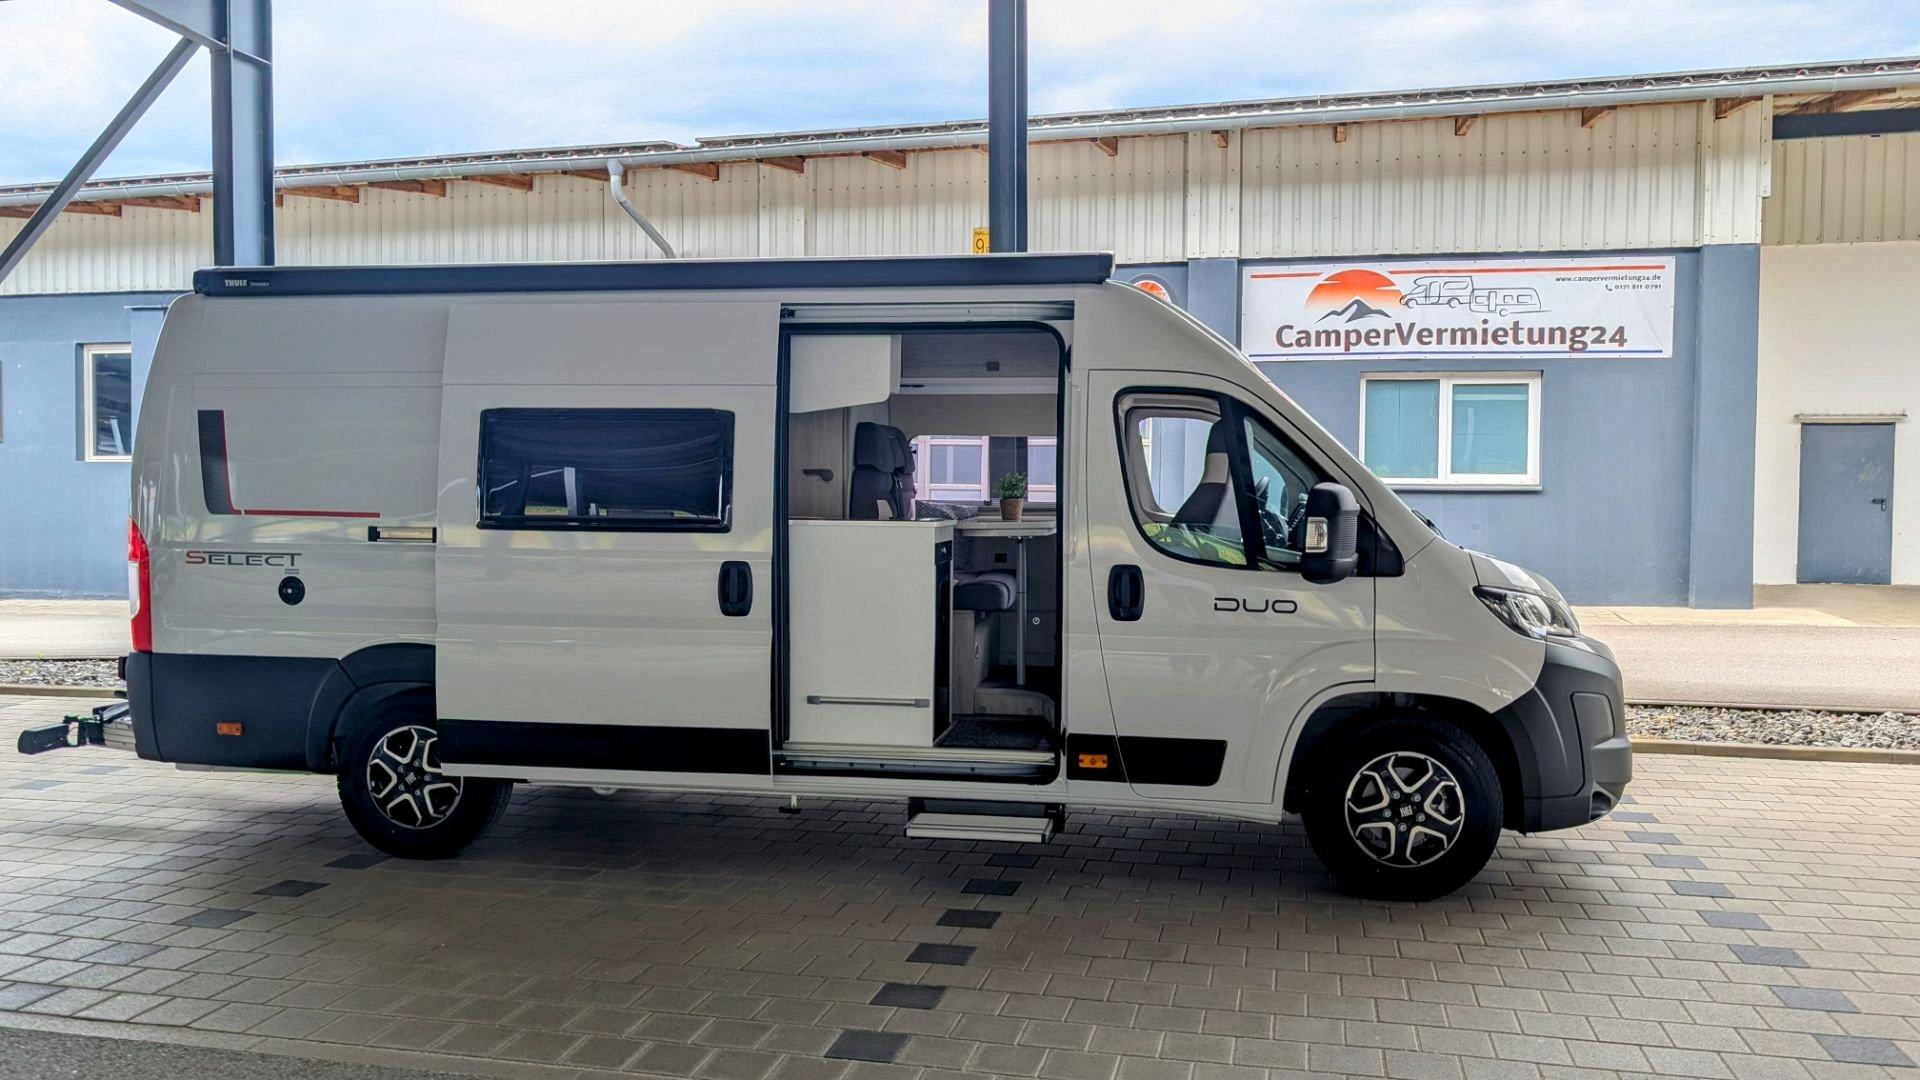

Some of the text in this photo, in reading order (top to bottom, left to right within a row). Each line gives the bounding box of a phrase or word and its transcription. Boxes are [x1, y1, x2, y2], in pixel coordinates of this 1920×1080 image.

[224, 279, 248, 287] THULE
[1555, 274, 1661, 282] www.campervermietung24.de
[1275, 318, 1628, 352] CamperVermietung24
[1214, 597, 1298, 614] DUO
